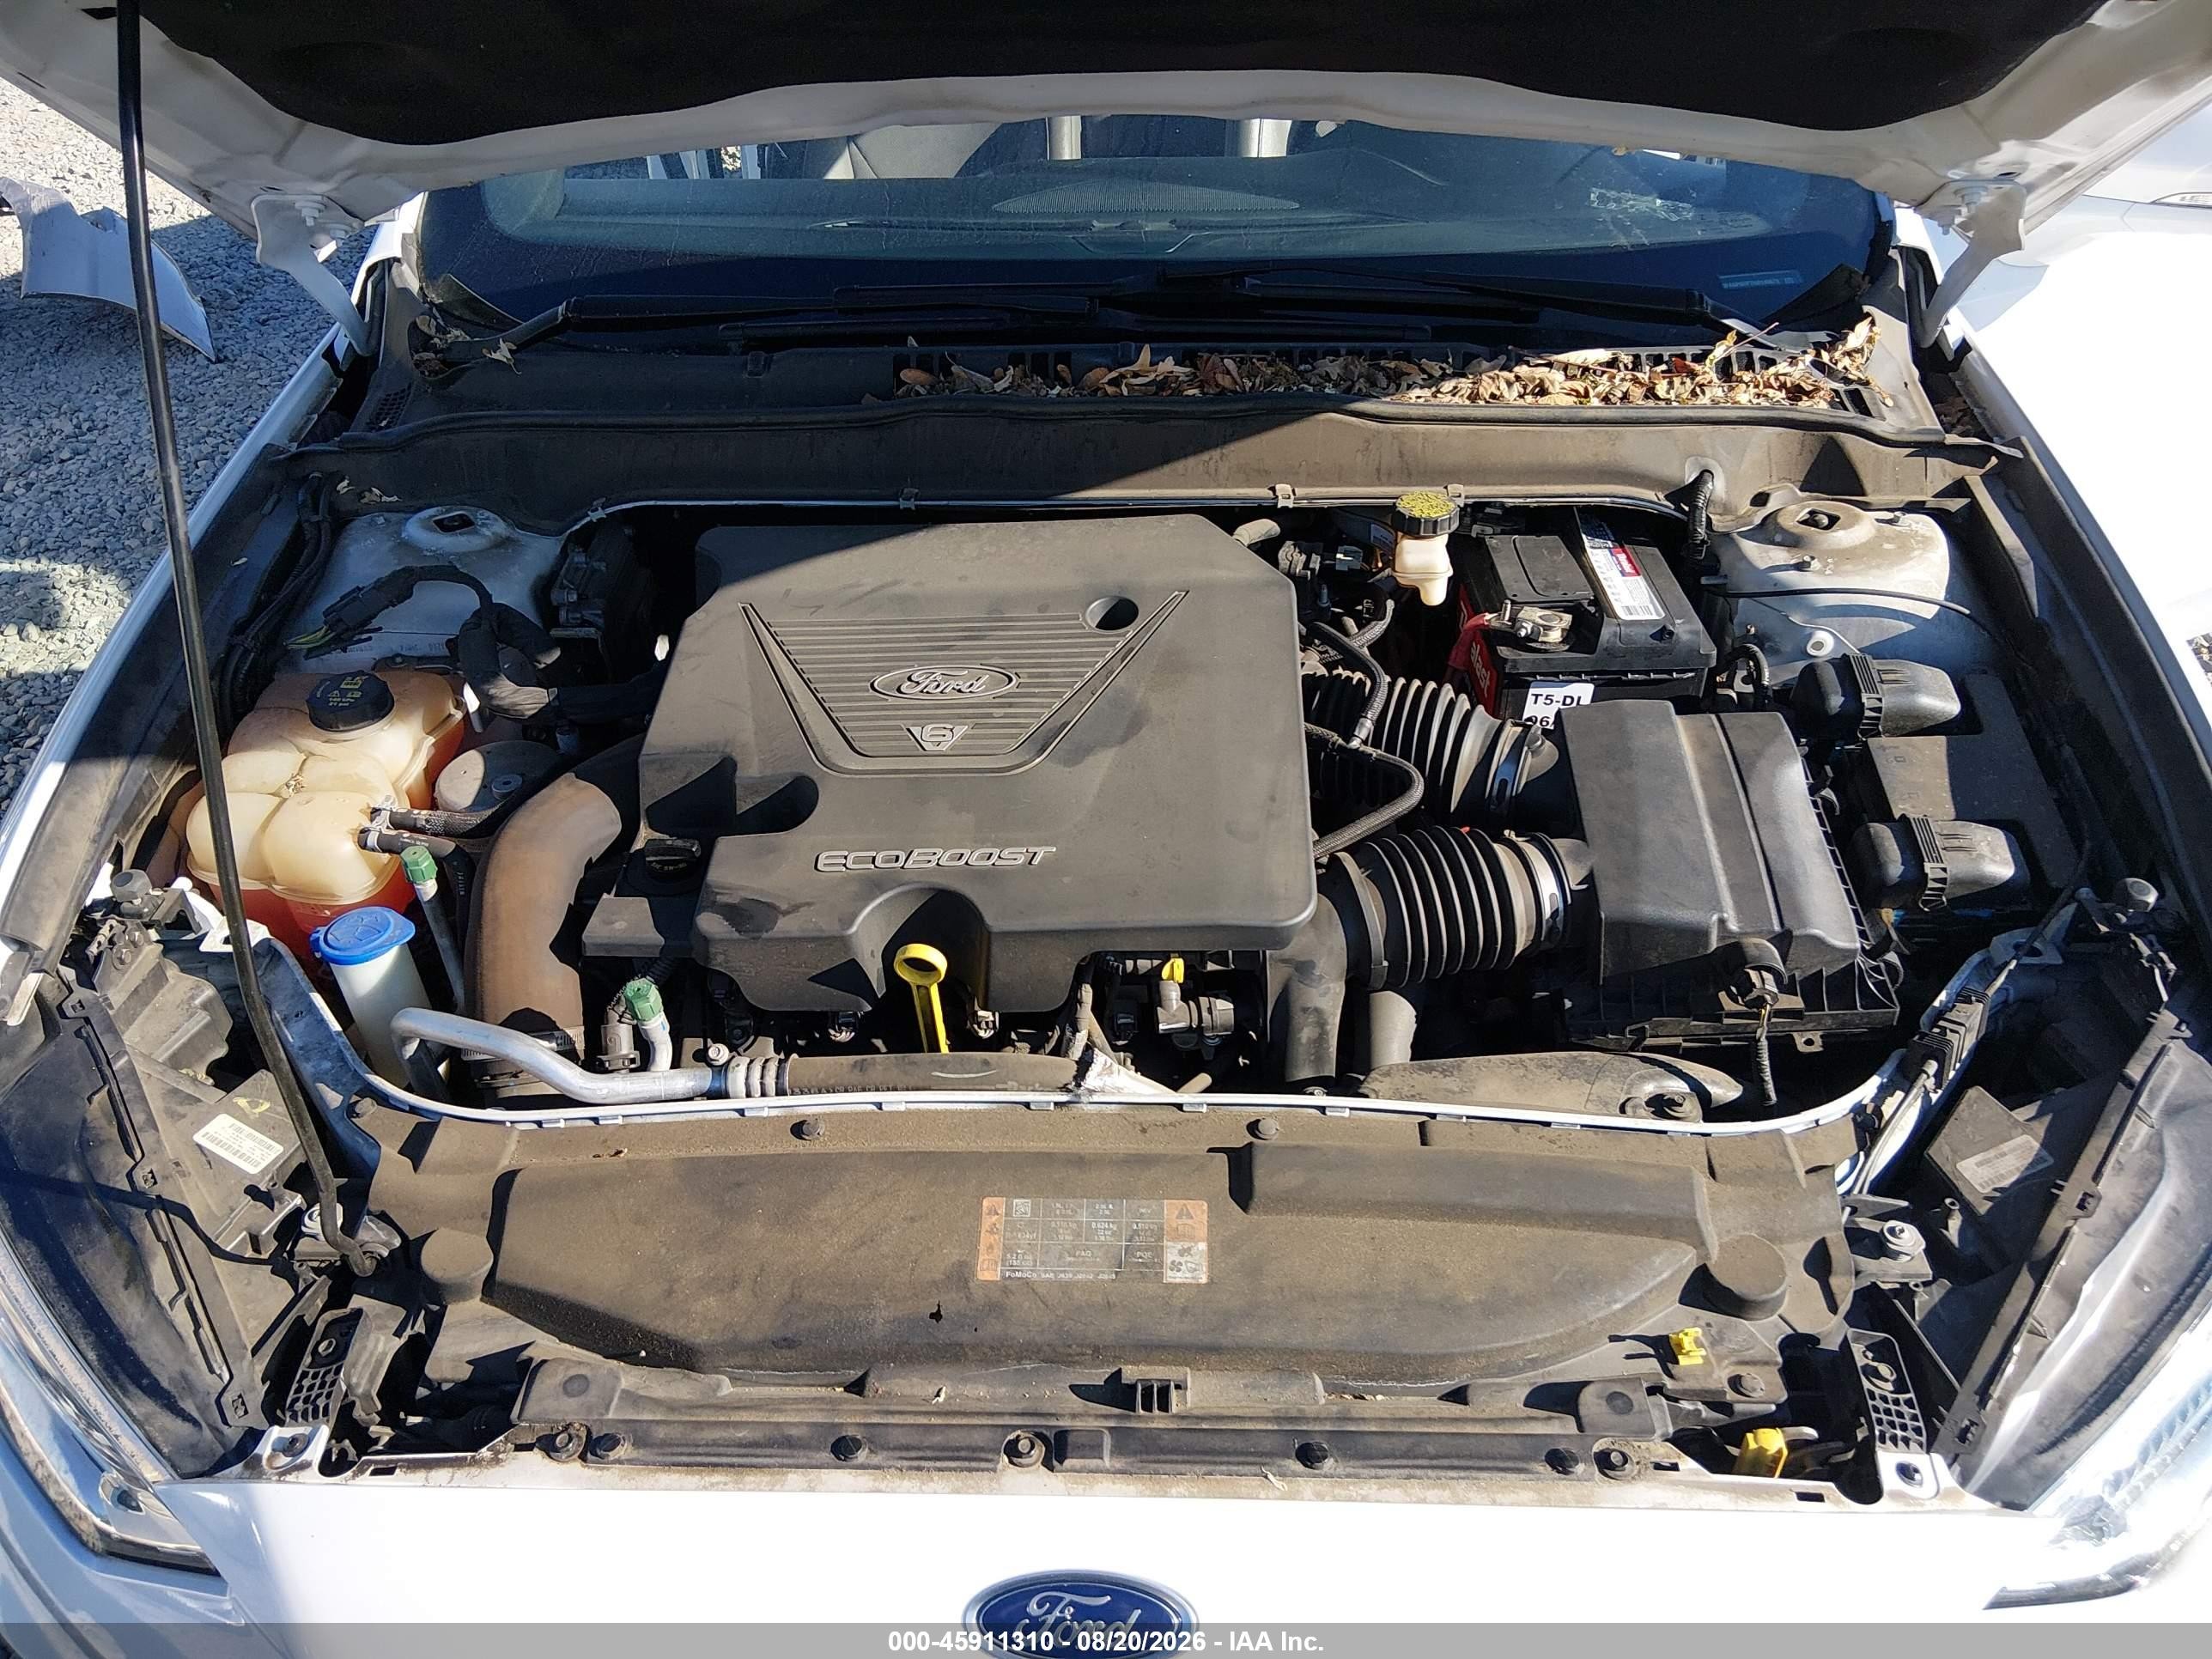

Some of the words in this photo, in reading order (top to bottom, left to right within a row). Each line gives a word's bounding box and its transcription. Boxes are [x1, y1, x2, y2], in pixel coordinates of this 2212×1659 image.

[896, 670, 989, 695] Ford
[1531, 693, 1587, 707] T5-DL
[815, 847, 1057, 872] ECOBOOST
[1006, 1270, 1037, 1279] FoMoCo
[1016, 1590, 1142, 1650] Ford
